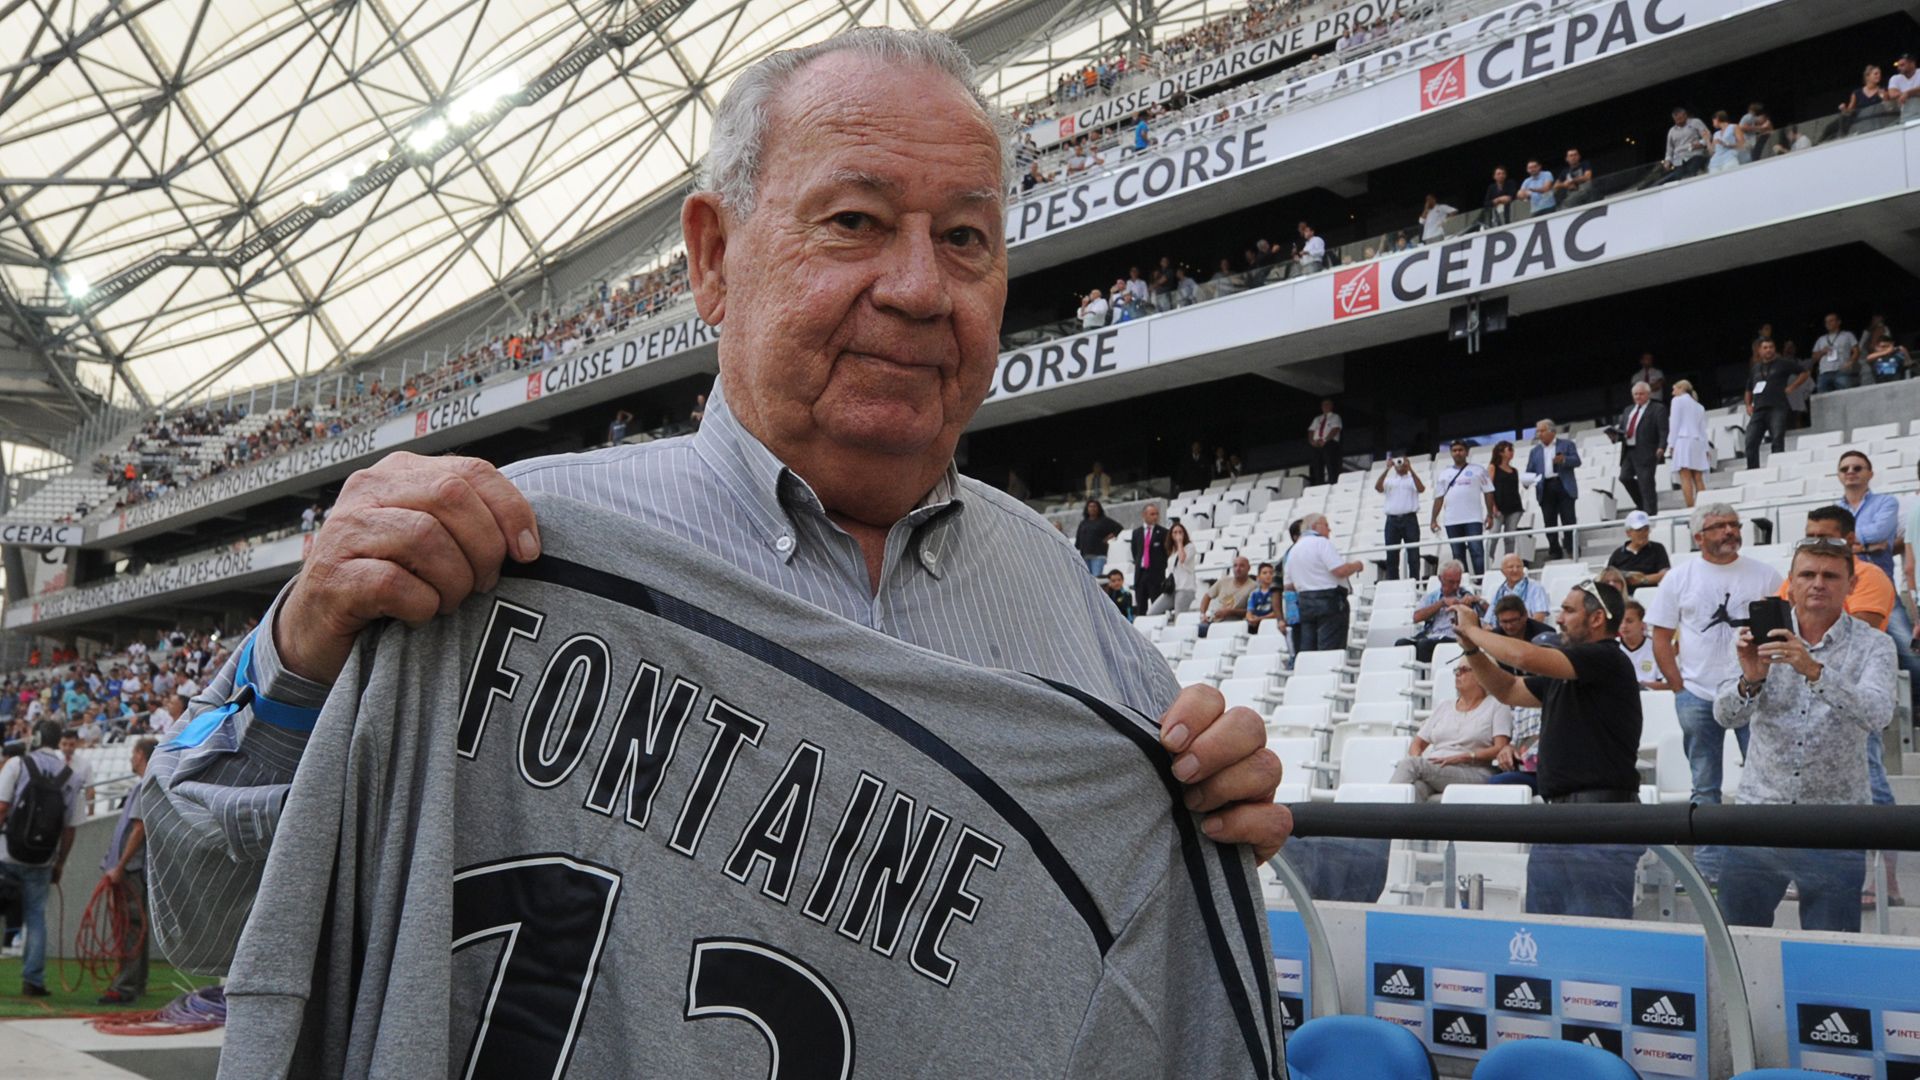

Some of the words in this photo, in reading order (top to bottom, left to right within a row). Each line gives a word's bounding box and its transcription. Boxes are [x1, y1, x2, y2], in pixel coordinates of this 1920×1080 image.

[1478, 0, 1686, 89] CEPAC
[1079, 87, 1151, 128] CAISSE
[1391, 205, 1607, 302] CEPAC
[545, 346, 615, 393] CAISSE
[985, 329, 1119, 398] ORSE
[430, 393, 481, 430] CEPAC
[3, 525, 69, 542] CEPAC
[457, 599, 1004, 987] FONTAINE
[1381, 985, 1415, 996] adidas
[1441, 983, 1484, 994] INTERSPORT
[1503, 999, 1542, 1011] adidas
[1571, 996, 1619, 1009] INTERSPORT
[1641, 1012, 1684, 1026] adidas
[1441, 1032, 1476, 1045] adidas
[1810, 1030, 1859, 1045] adidas
[1642, 1048, 1694, 1062] INTERSPORT
